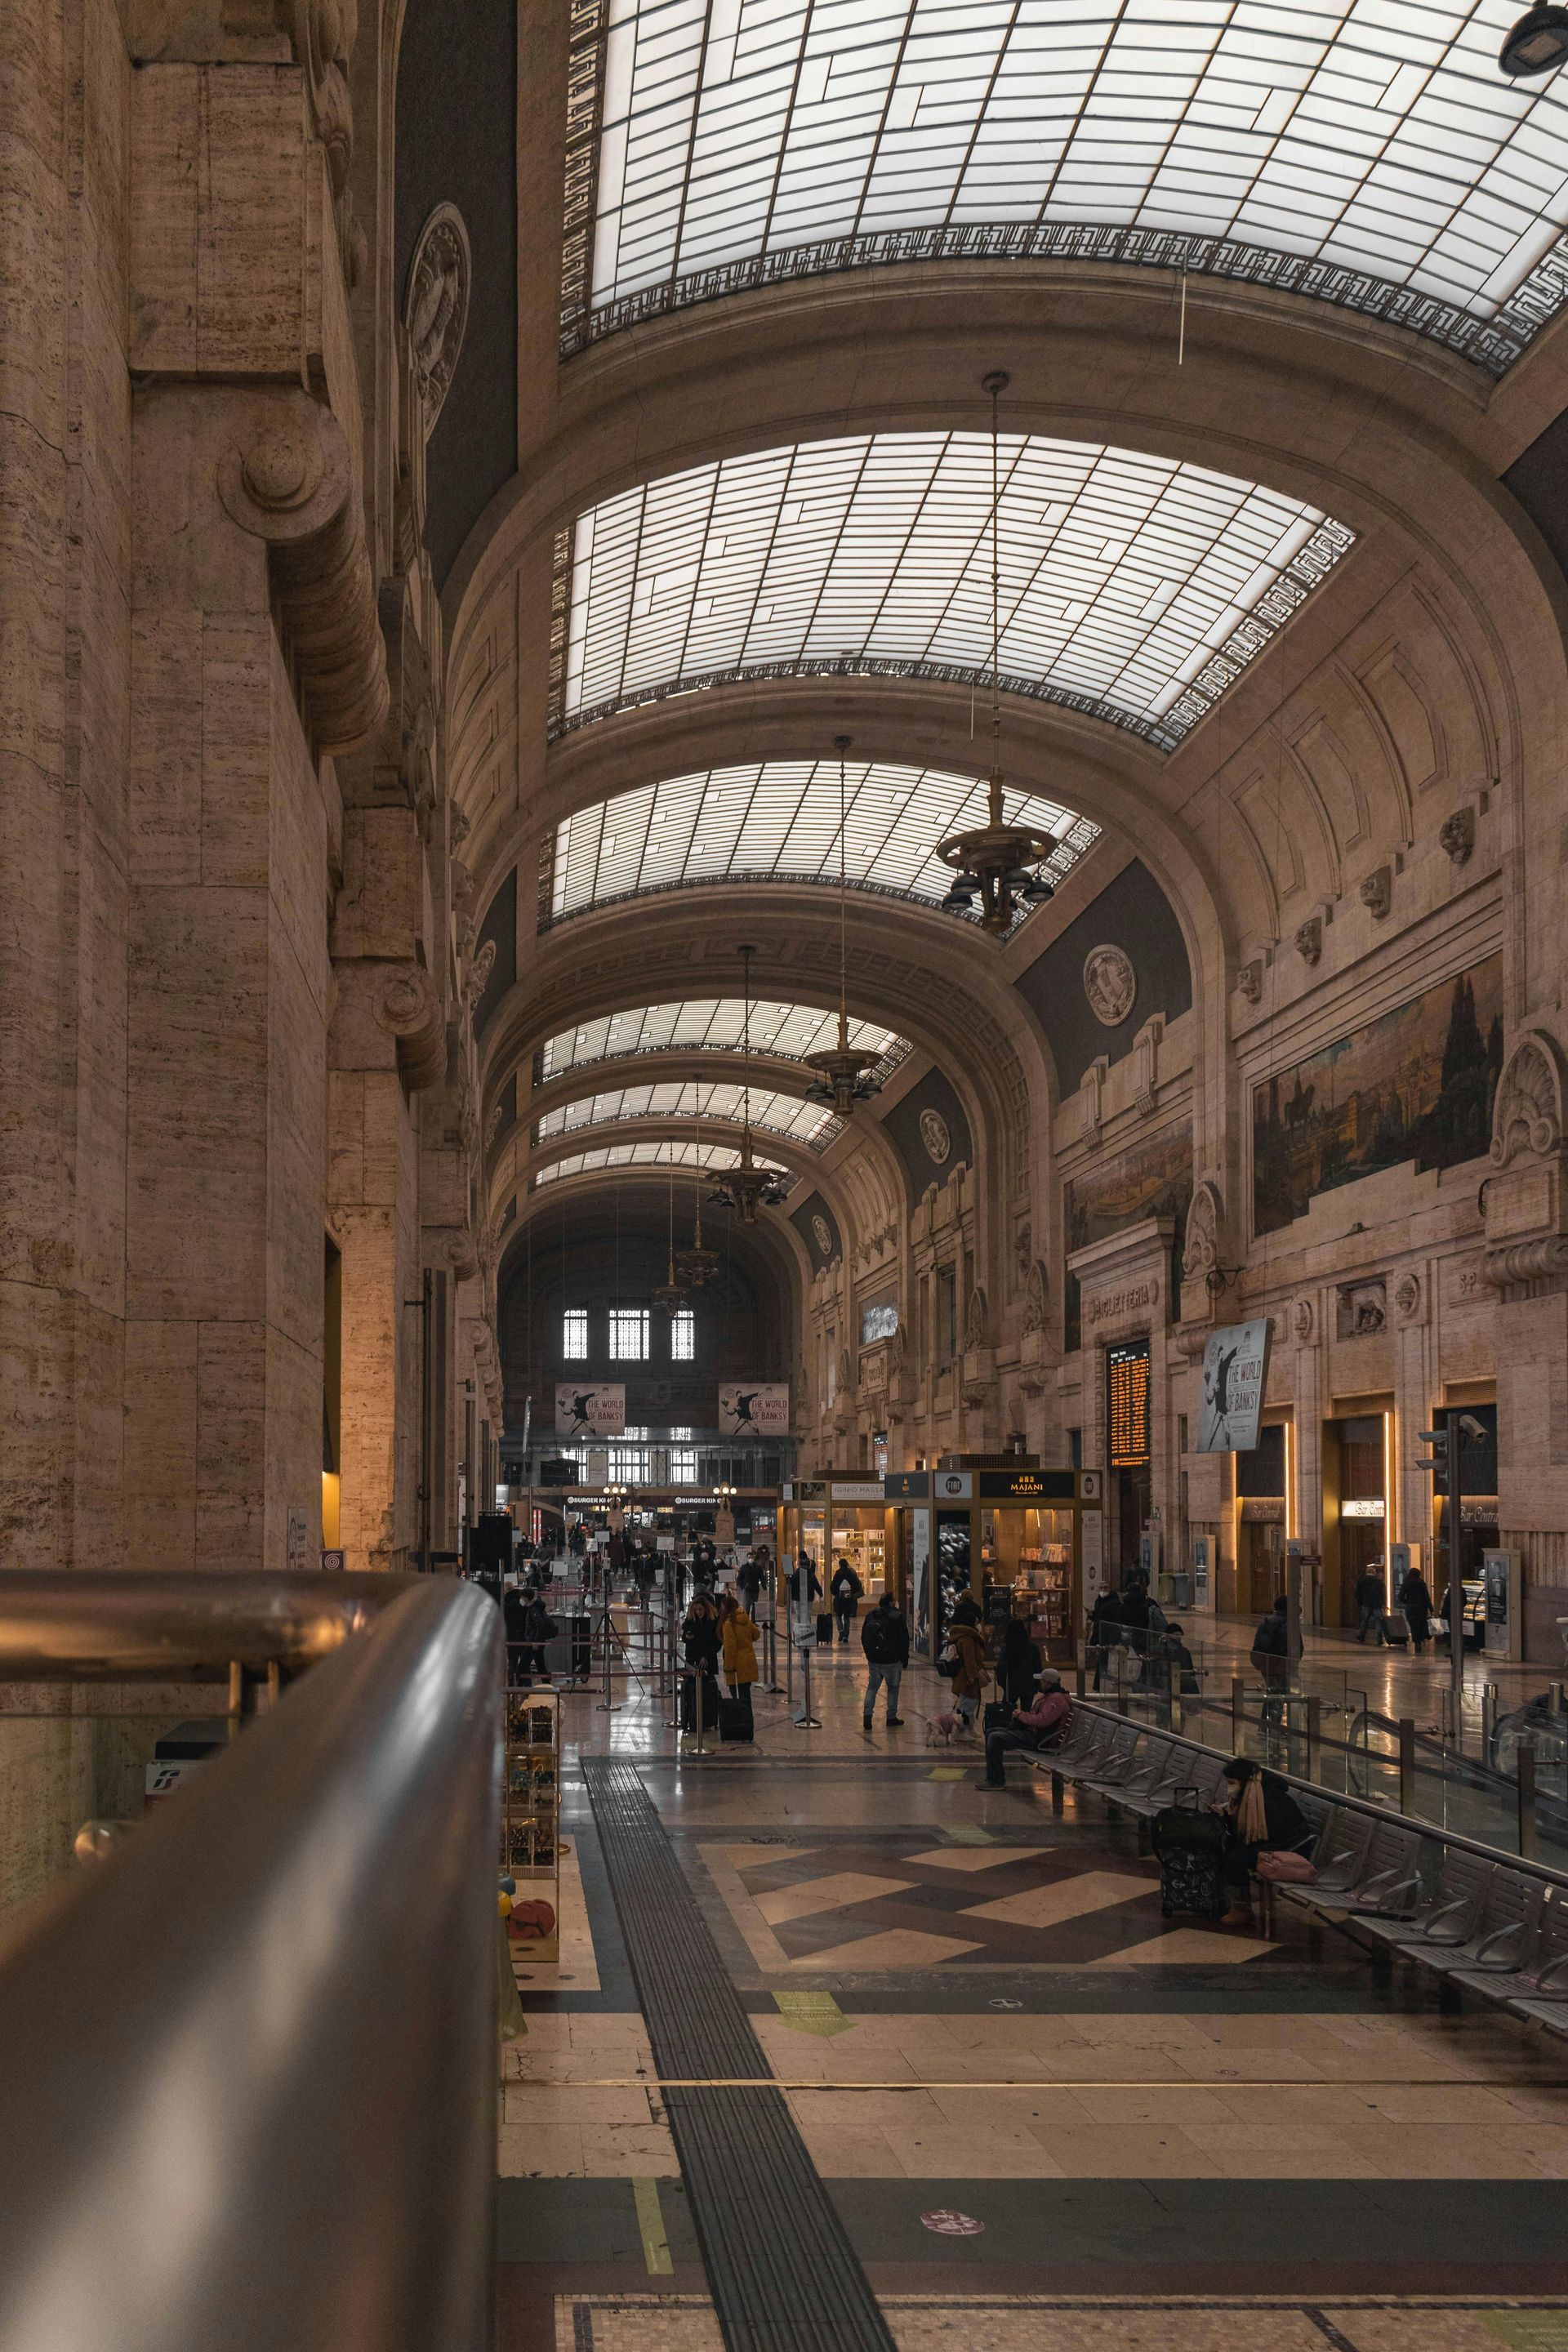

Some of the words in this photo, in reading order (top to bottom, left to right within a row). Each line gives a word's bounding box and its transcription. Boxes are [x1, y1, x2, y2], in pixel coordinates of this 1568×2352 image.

[1095, 1285, 1149, 1321] BIGLIETTERIA
[1228, 1365, 1240, 1384] THE
[1241, 1361, 1262, 1382] WORLD
[588, 1400, 599, 1408] THE
[601, 1400, 624, 1408] WORLD
[751, 1400, 763, 1408] THE
[764, 1400, 787, 1408] WORLD
[1227, 1394, 1235, 1412] OF
[1235, 1390, 1259, 1412] BANKSY
[588, 1412, 596, 1420] OF
[598, 1412, 624, 1420] BANKSY
[751, 1412, 760, 1420] OF
[761, 1412, 787, 1420] BANKSY
[947, 1481, 960, 1490] FIAT
[1010, 1483, 1043, 1491] MAJANI
[1460, 1506, 1473, 1522] Bar
